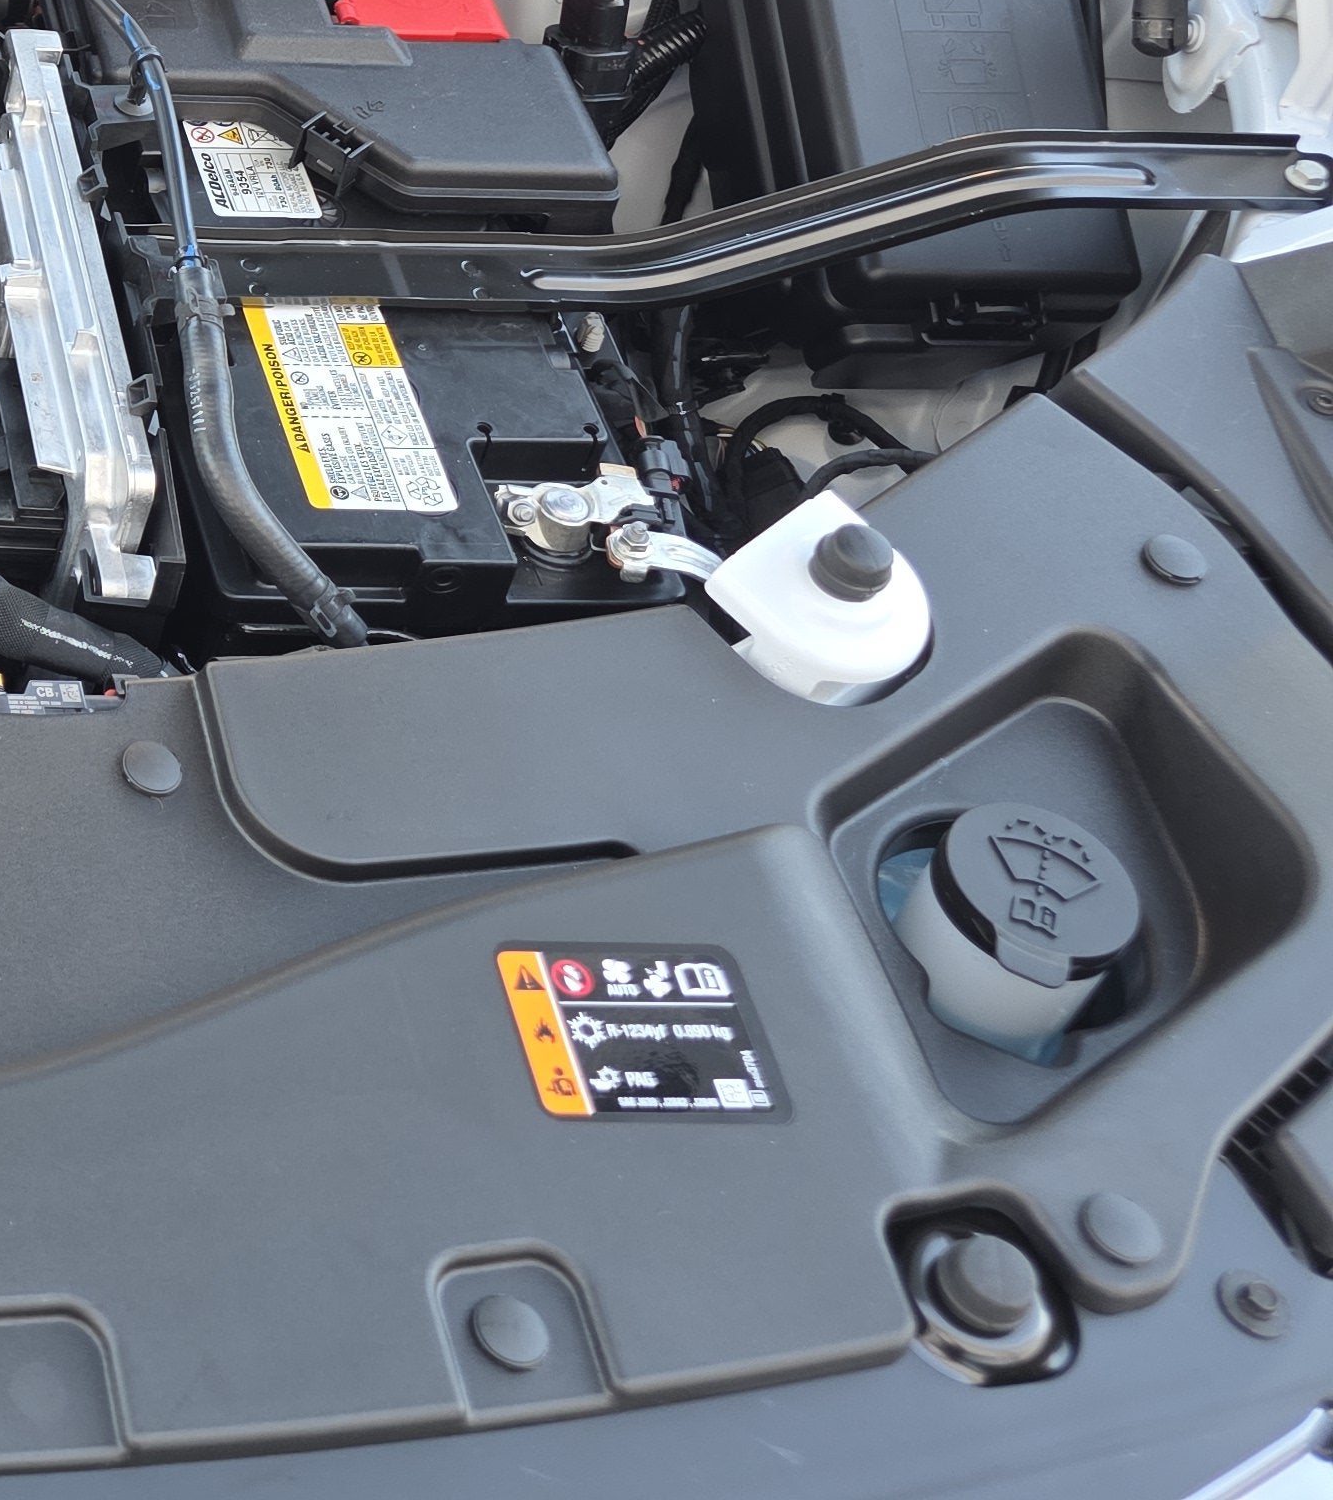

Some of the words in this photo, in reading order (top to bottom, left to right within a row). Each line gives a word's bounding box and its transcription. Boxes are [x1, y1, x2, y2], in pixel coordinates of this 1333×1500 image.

[263, 157, 273, 169] 730
[200, 153, 229, 208] ACDelco
[233, 170, 252, 194] 9354
[245, 165, 260, 184] VRLA
[277, 195, 288, 207] 730
[271, 319, 288, 345] SULFURIC
[282, 321, 291, 331] CAN
[304, 313, 322, 343] SULFURIQUE
[285, 332, 296, 344] ACID
[261, 343, 306, 441] DANGER/POISON
[325, 390, 341, 409] ÉVITER
[320, 433, 334, 451] GASES
[328, 452, 346, 483] EXPLOSIVE
[359, 460, 370, 470] LES
[363, 446, 382, 476] EXPLOSIFS
[323, 464, 337, 483] SHIELD
[375, 478, 387, 489] GAZ
[380, 491, 392, 501] LES
[36, 687, 54, 698] CB
[606, 984, 639, 996] AUTO
[605, 1024, 666, 1042] R-1234yf
[711, 1025, 735, 1041] kg
[624, 1072, 659, 1088] PAG
